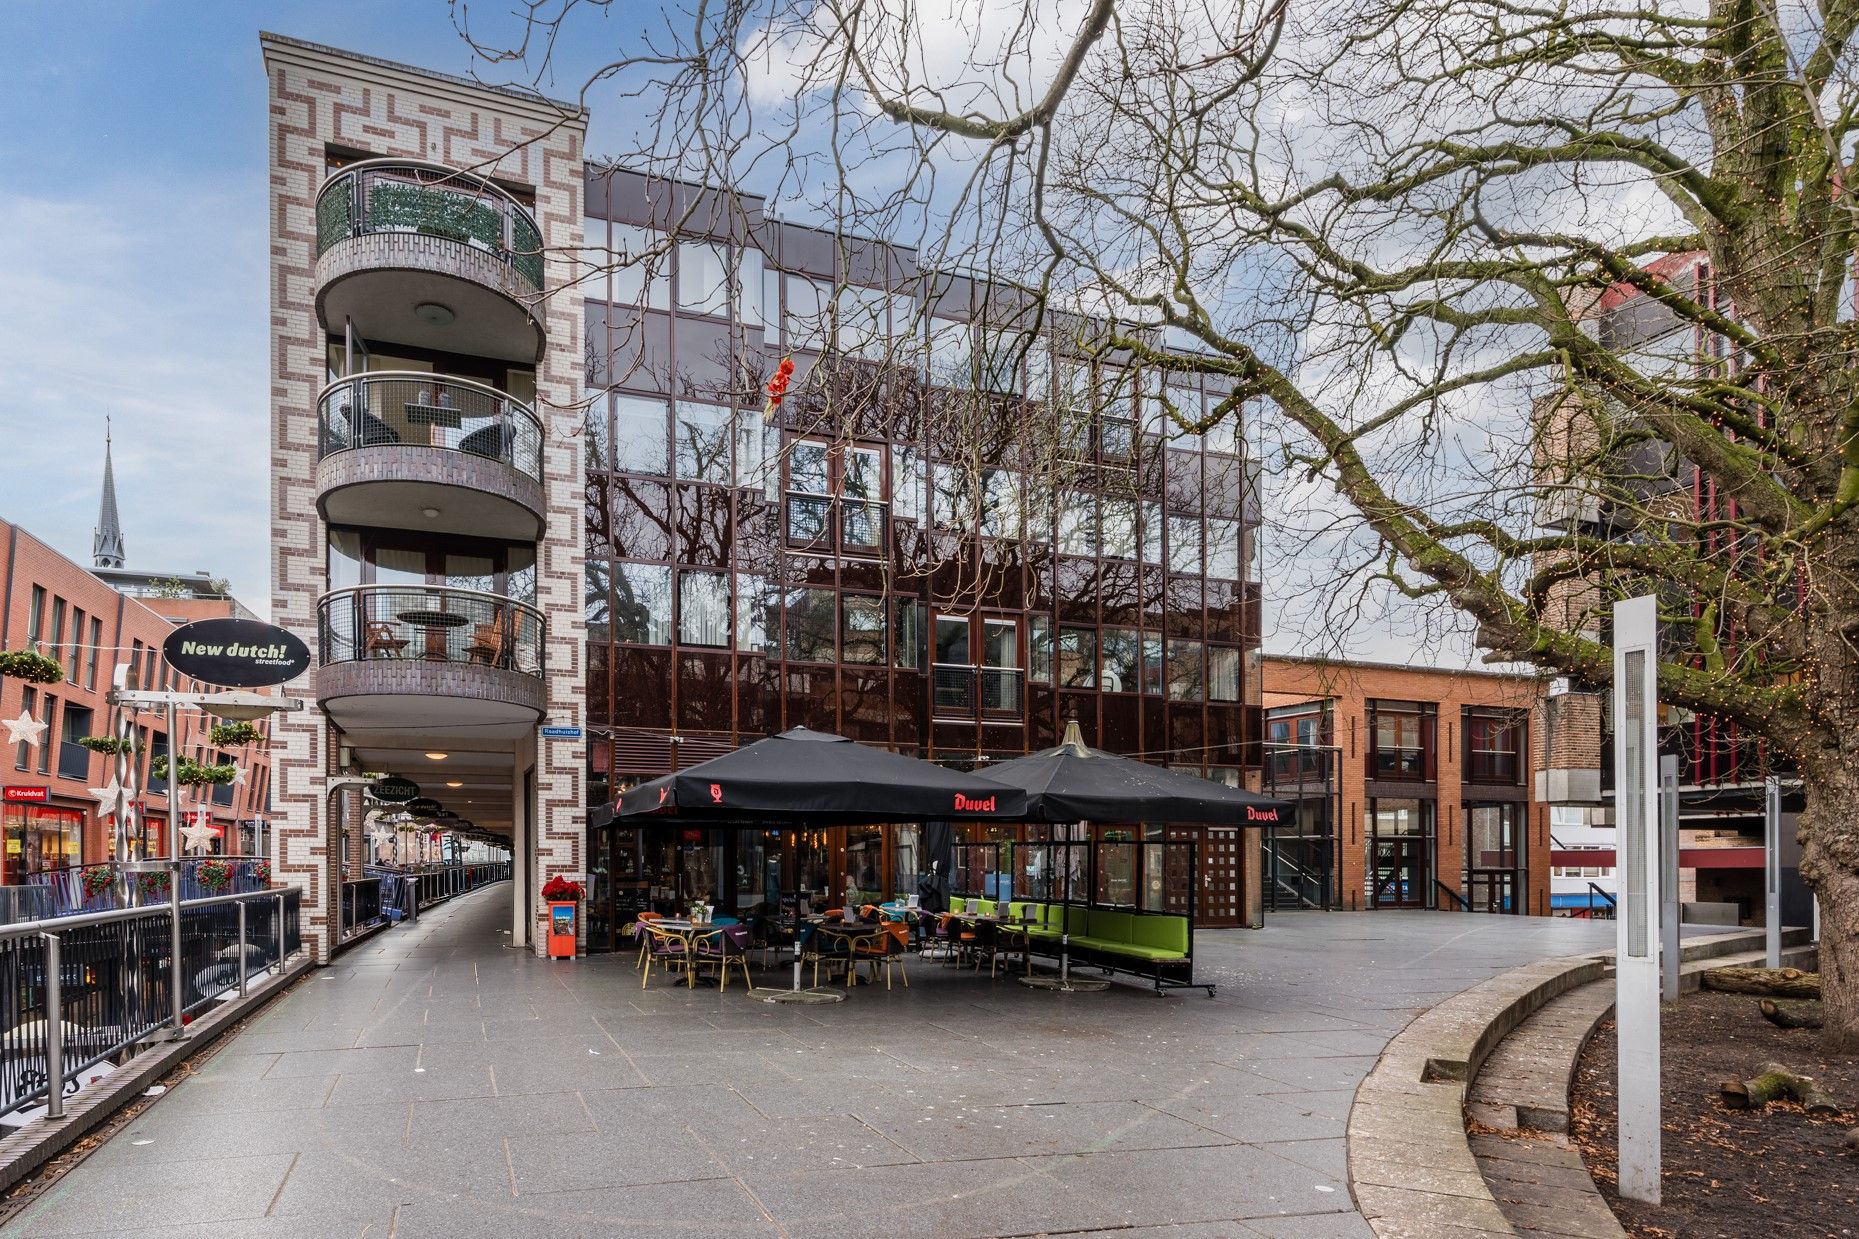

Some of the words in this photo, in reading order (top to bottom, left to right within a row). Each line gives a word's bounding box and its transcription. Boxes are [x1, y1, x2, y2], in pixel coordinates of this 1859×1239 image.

[181, 641, 223, 656] New
[226, 642, 287, 659] dutch!
[373, 785, 417, 796] ZEEZICHT
[954, 792, 996, 812] Duvel
[1246, 805, 1279, 821] Duvel
